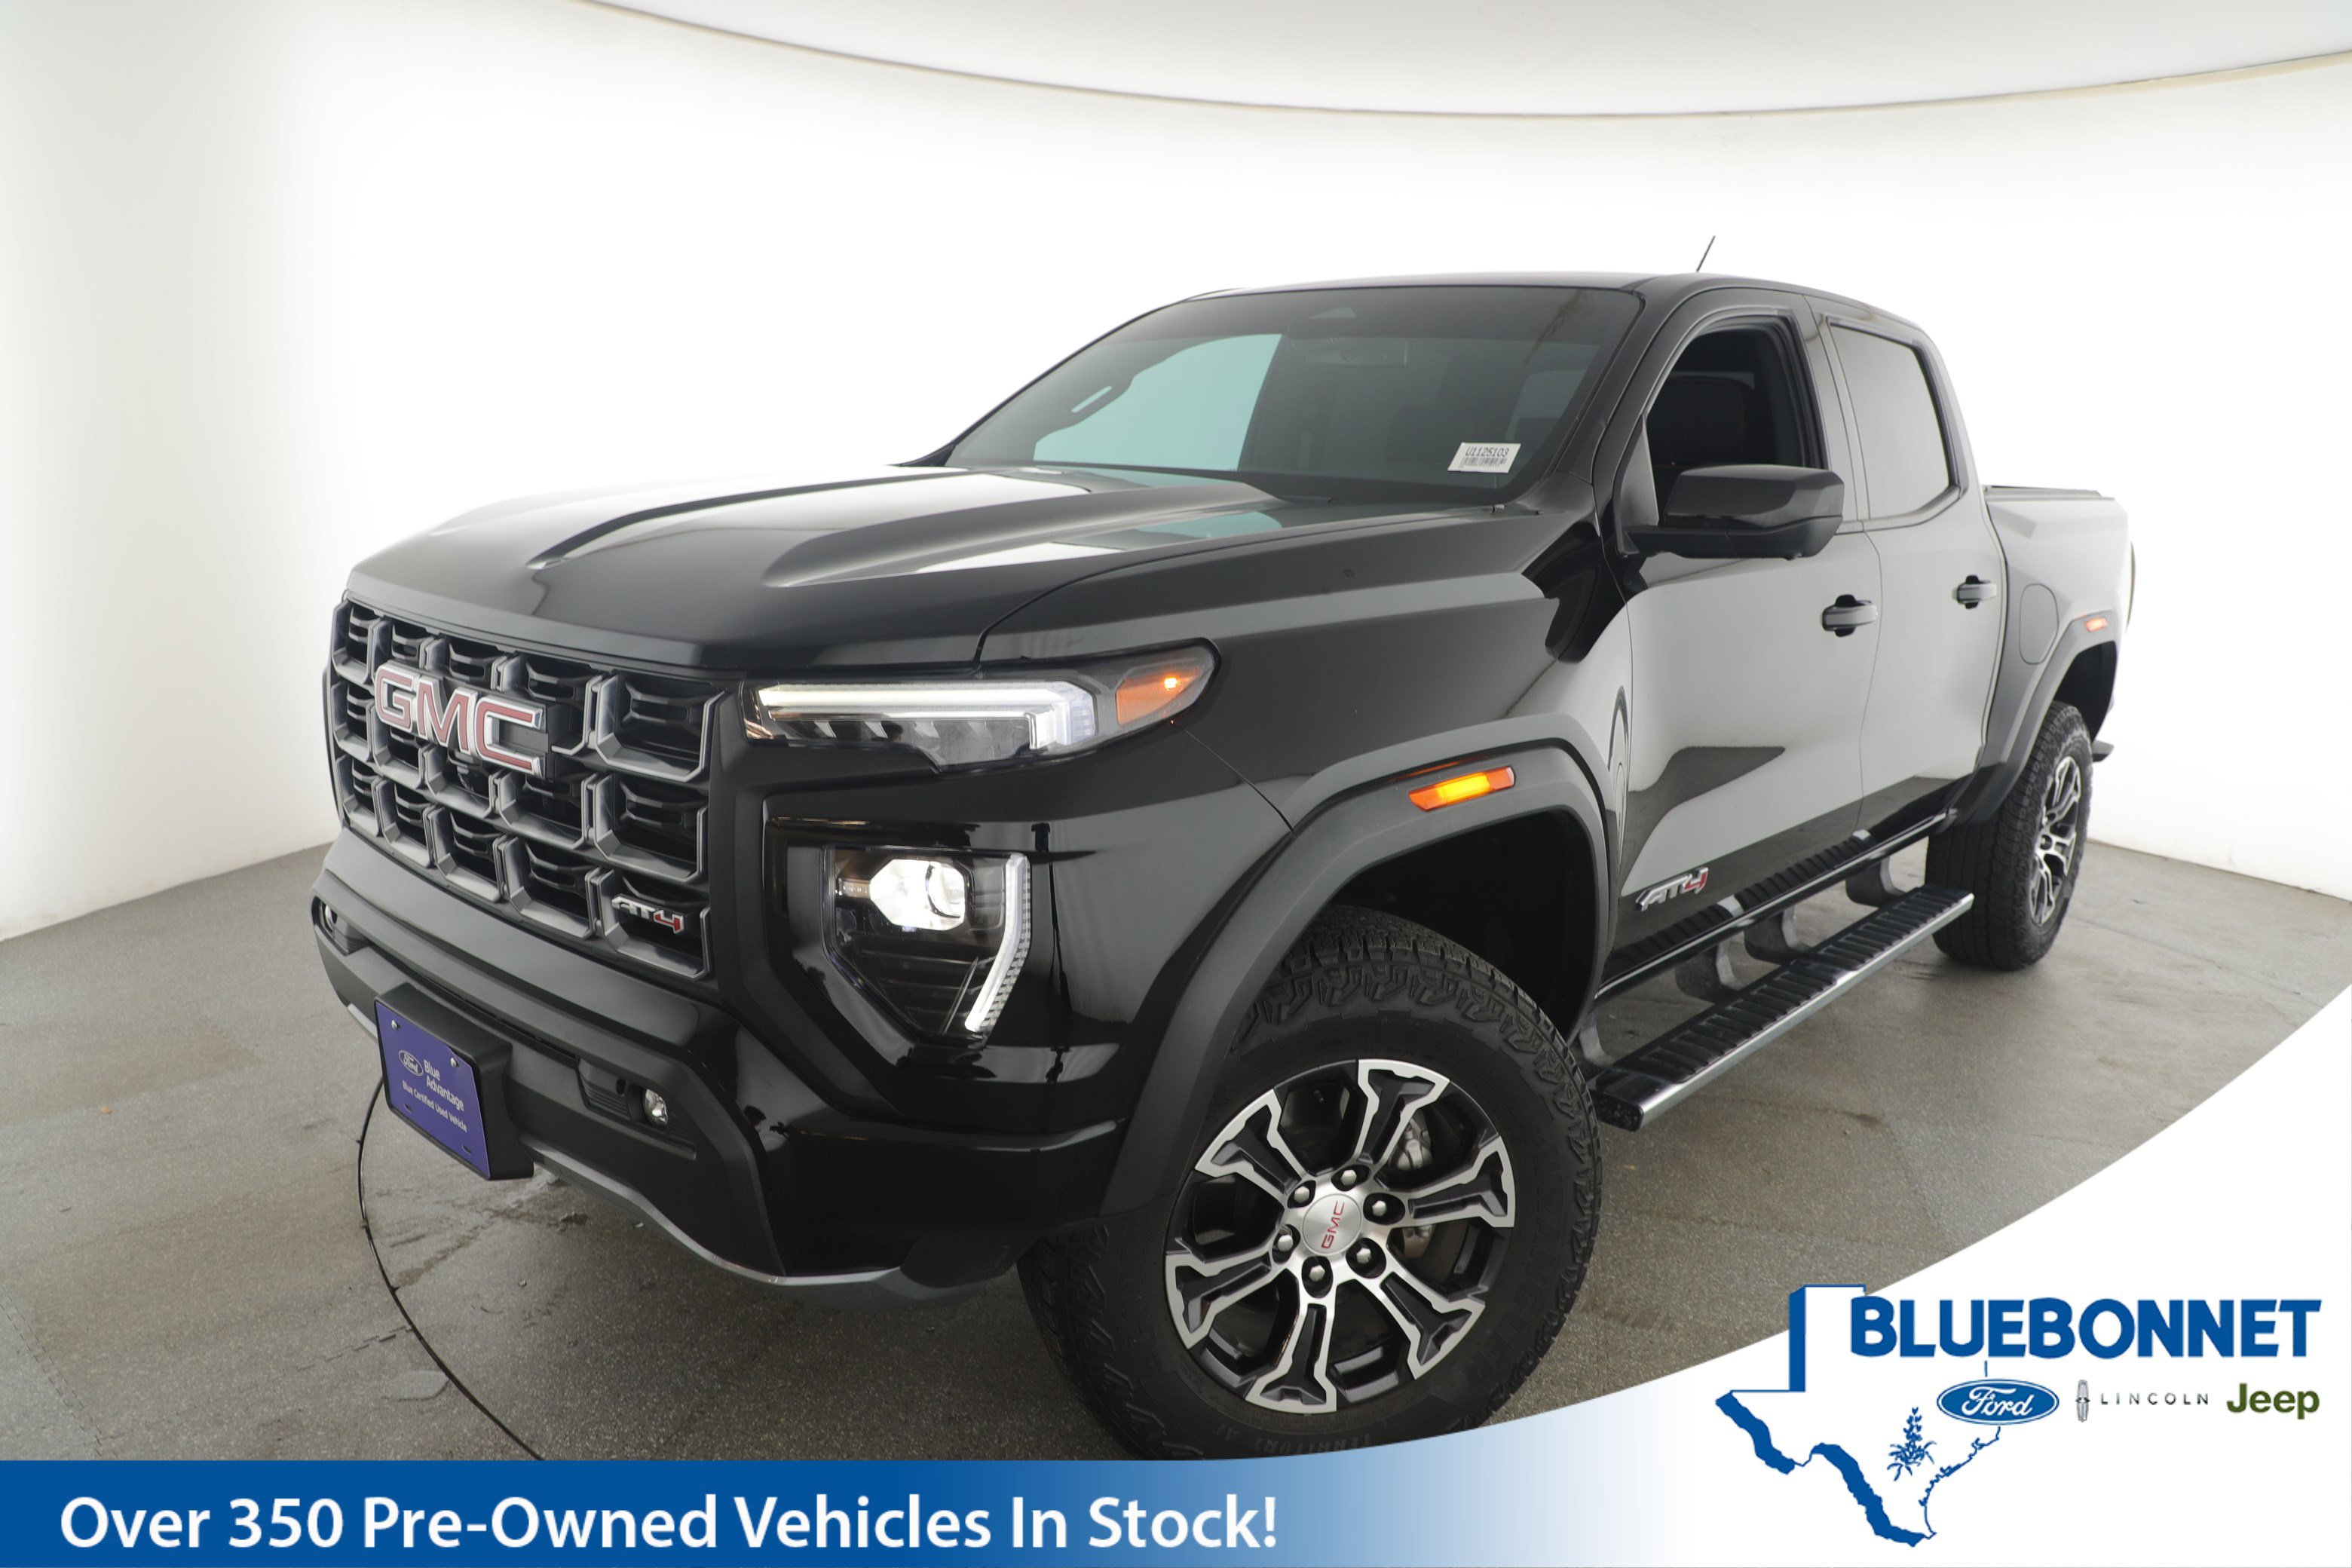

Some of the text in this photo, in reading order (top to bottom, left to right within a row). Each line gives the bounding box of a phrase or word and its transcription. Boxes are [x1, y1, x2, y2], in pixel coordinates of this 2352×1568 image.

[1465, 446, 1510, 458] U1125103
[374, 660, 545, 779] GMC
[1635, 867, 1709, 911] AT4
[611, 893, 684, 934] AT4
[423, 1058, 441, 1081] Blue
[402, 1080, 467, 1132] Blue Certified Used Vehicle
[426, 1075, 464, 1111] Advantage
[1321, 1200, 1346, 1250] GMC
